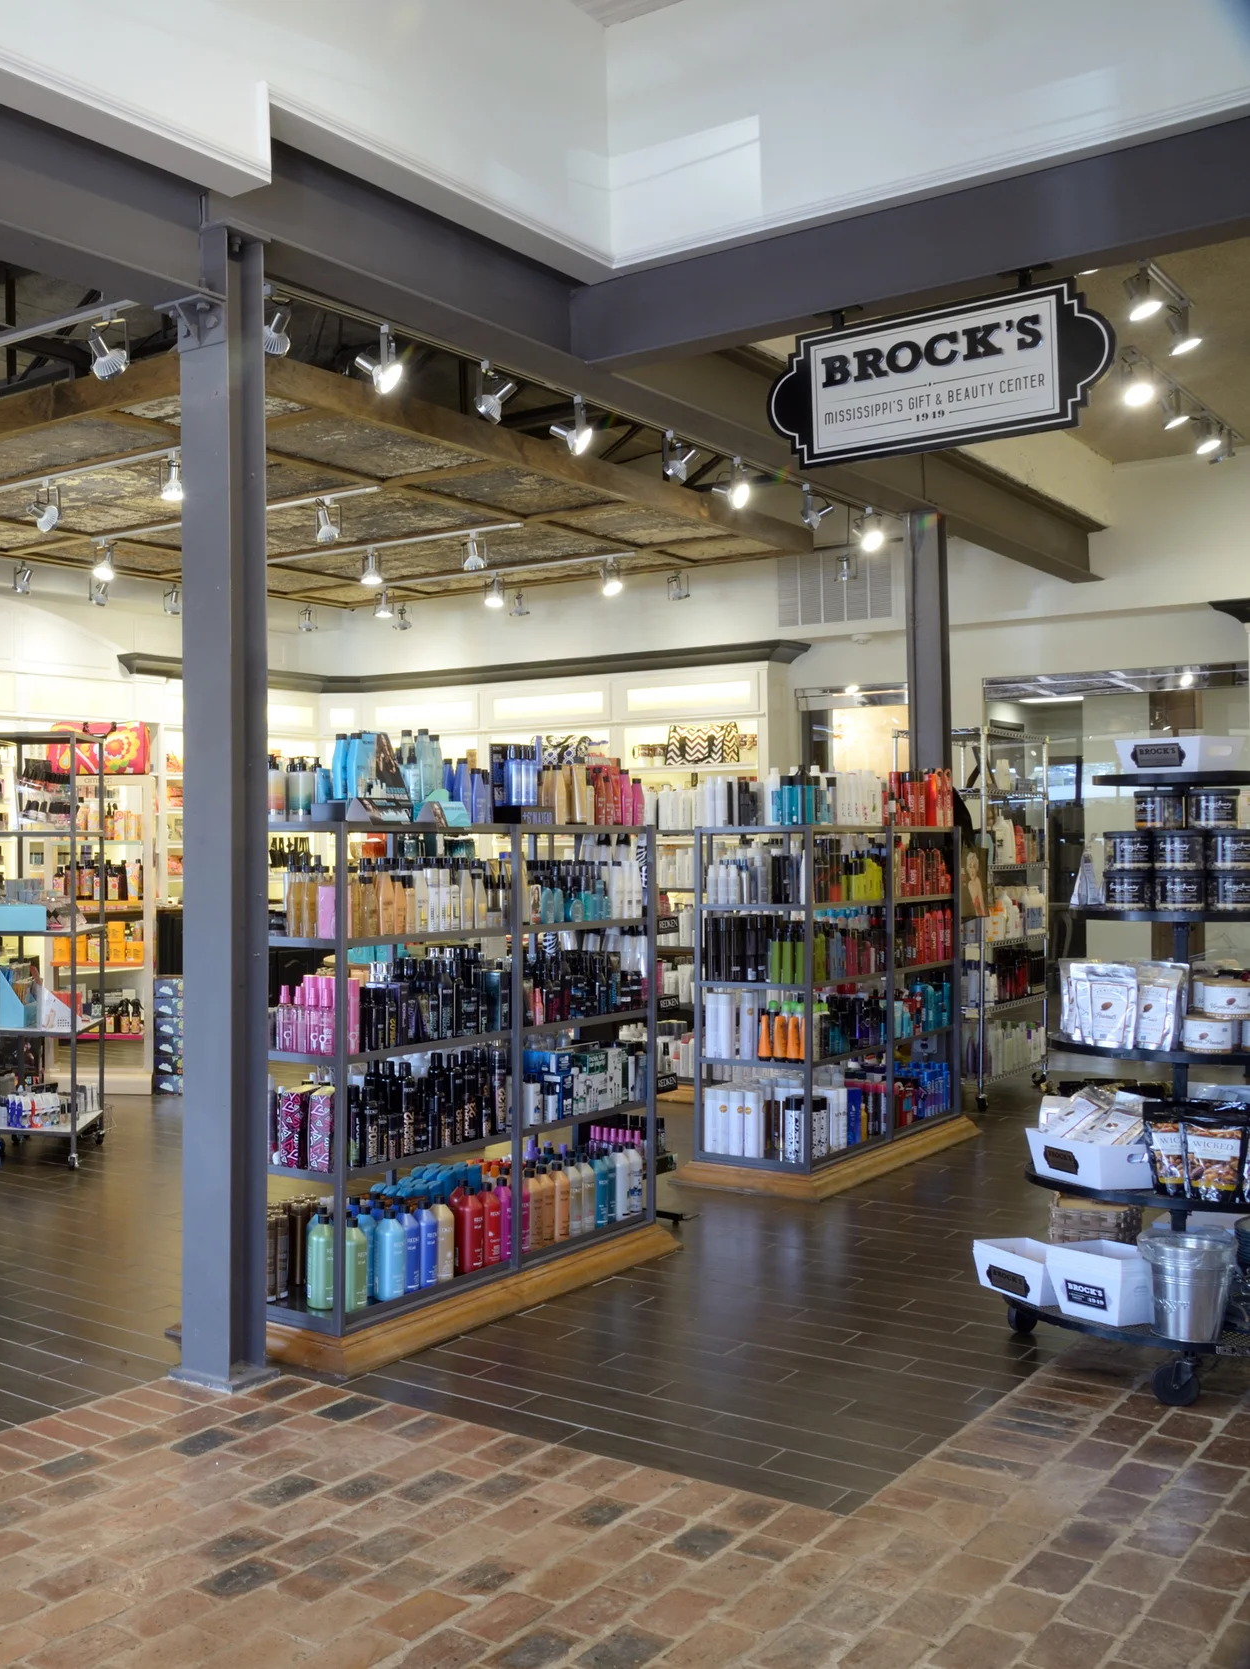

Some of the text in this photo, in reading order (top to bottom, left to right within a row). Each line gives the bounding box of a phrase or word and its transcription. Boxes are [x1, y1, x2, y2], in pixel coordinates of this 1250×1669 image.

[821, 314, 1044, 388] BROCK'S
[824, 373, 1046, 425] MISSISSIPPI'S GIFT & BEAUTY CENTER
[915, 409, 945, 422] 1949
[1139, 747, 1176, 756] BROCK'S
[658, 919, 678, 930] REDKEN
[660, 998, 679, 1008] REDKEN
[657, 1077, 676, 1087] REDKEN
[404, 1111, 414, 1124] 12
[368, 1125, 377, 1140] 05
[1192, 1140, 1234, 1150] WICKED
[1067, 1282, 1103, 1298] BROCK'S
